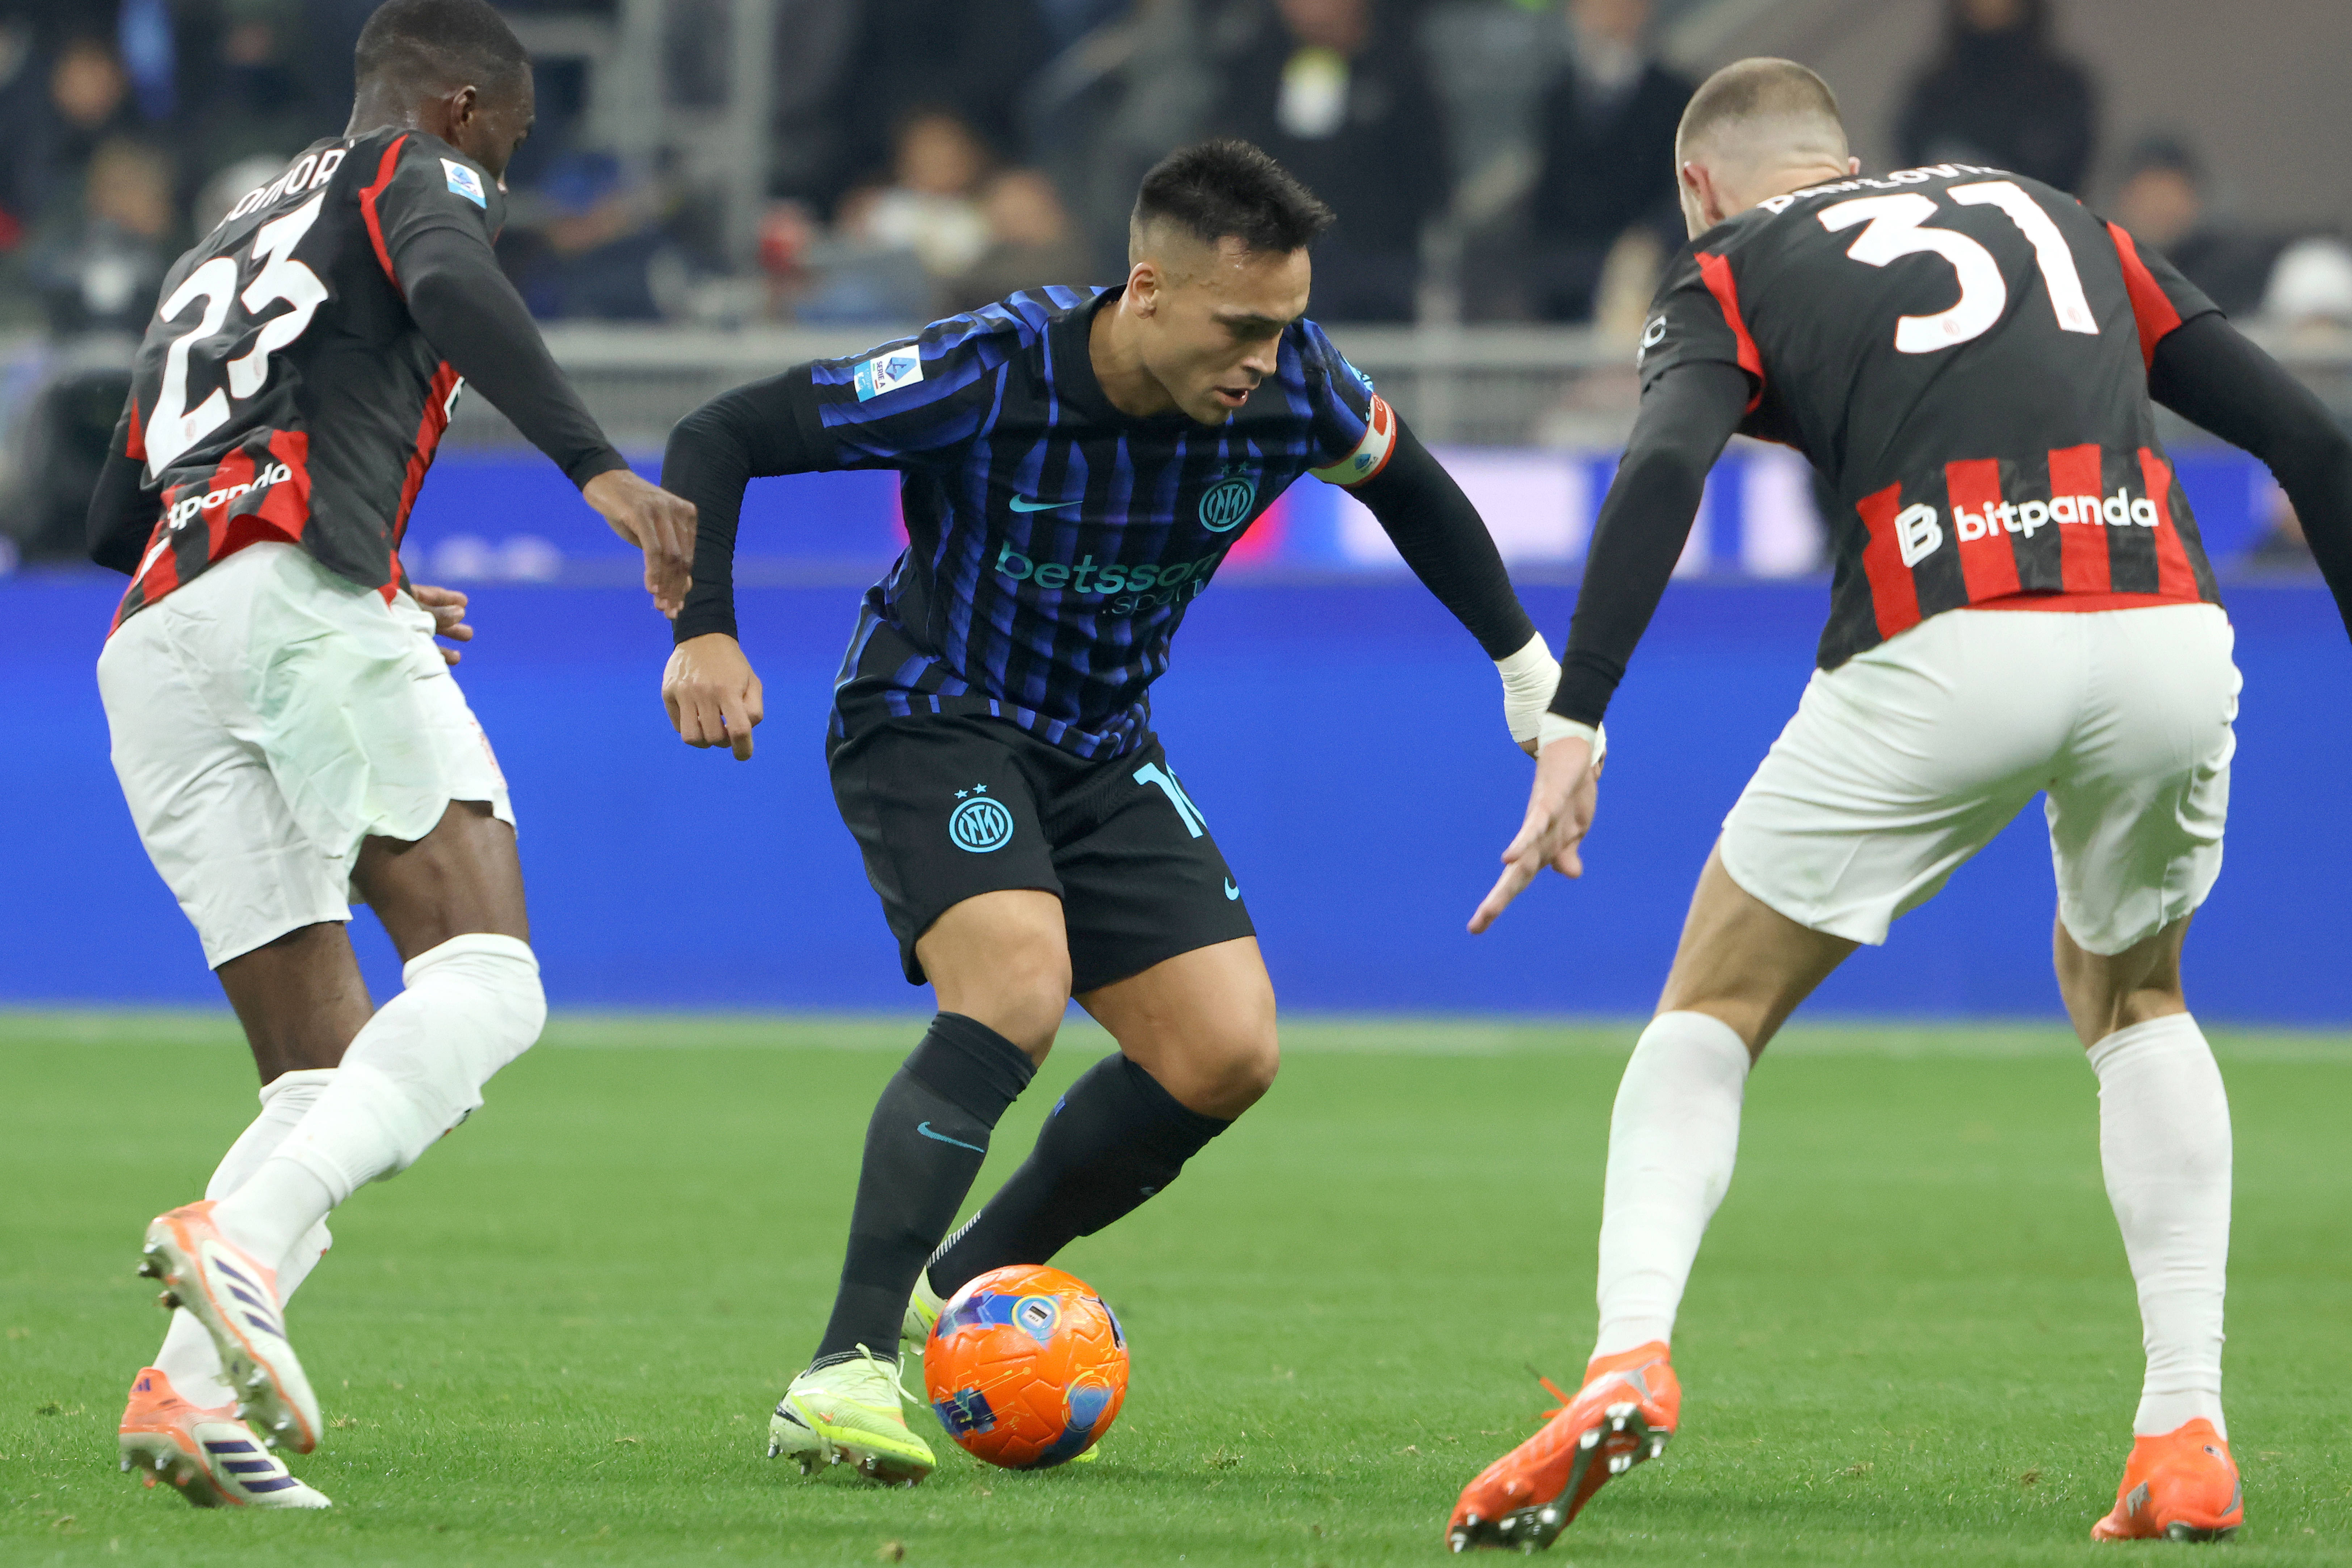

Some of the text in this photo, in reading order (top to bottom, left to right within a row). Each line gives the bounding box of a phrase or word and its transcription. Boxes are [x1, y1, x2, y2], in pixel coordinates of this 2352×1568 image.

[217, 139, 356, 231] OMOR
[1817, 181, 2100, 354] 31
[144, 190, 329, 480] 23
[876, 361, 885, 380] SERIE
[167, 462, 292, 530] tpanda
[1953, 487, 2159, 543] bitpanda
[995, 539, 1219, 594] betsson
